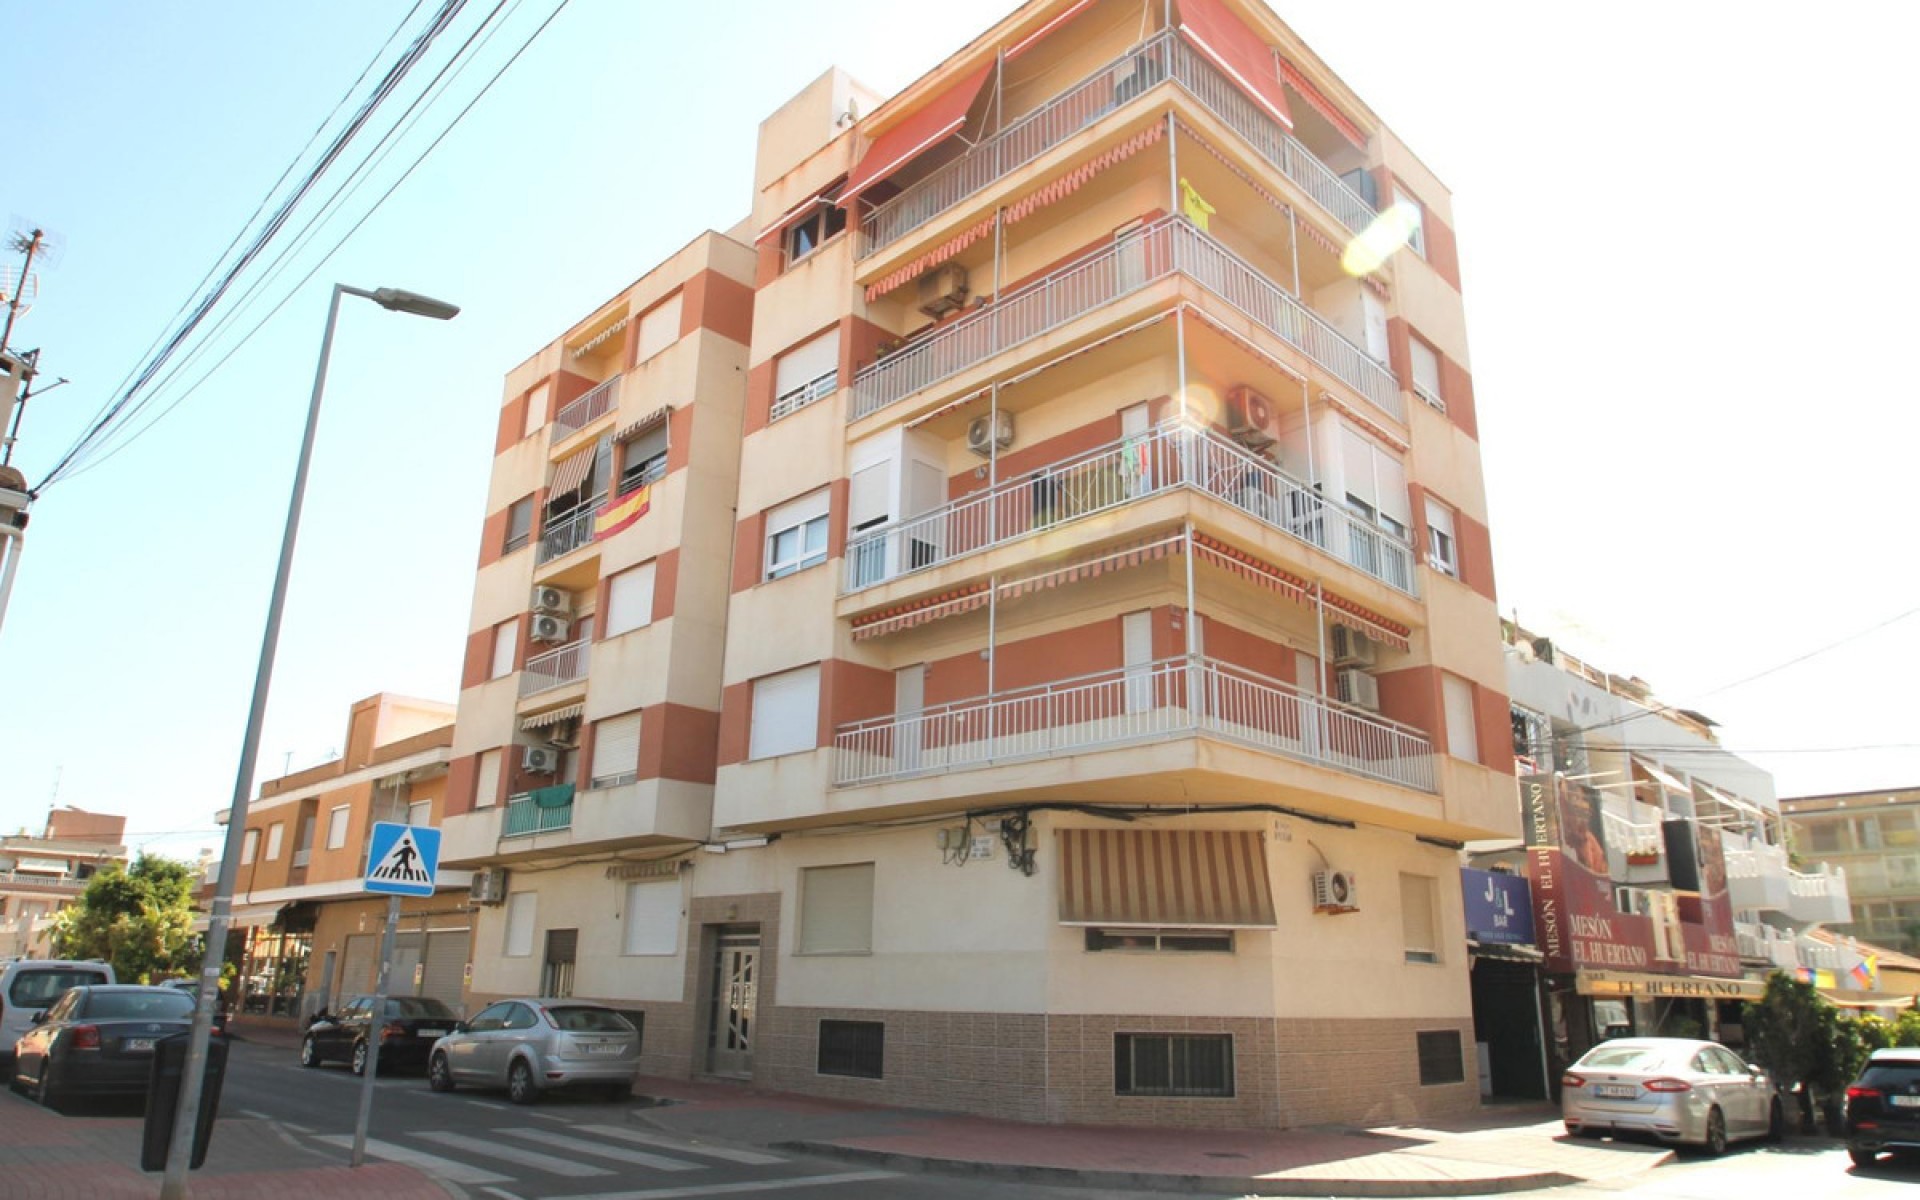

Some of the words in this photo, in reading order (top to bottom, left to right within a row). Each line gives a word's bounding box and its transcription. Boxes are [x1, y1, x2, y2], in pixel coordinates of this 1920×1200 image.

[1531, 783, 1550, 866] HUERTANO
[1541, 868, 1553, 889] EL
[1493, 913, 1508, 928] BAR
[1543, 899, 1561, 958] MESÓN
[1569, 913, 1612, 939] MESÓN
[1572, 940, 1590, 963] EL
[1589, 942, 1647, 967] HUERTANO
[1618, 980, 1635, 994] EL
[1646, 980, 1742, 996] HUERTANO
